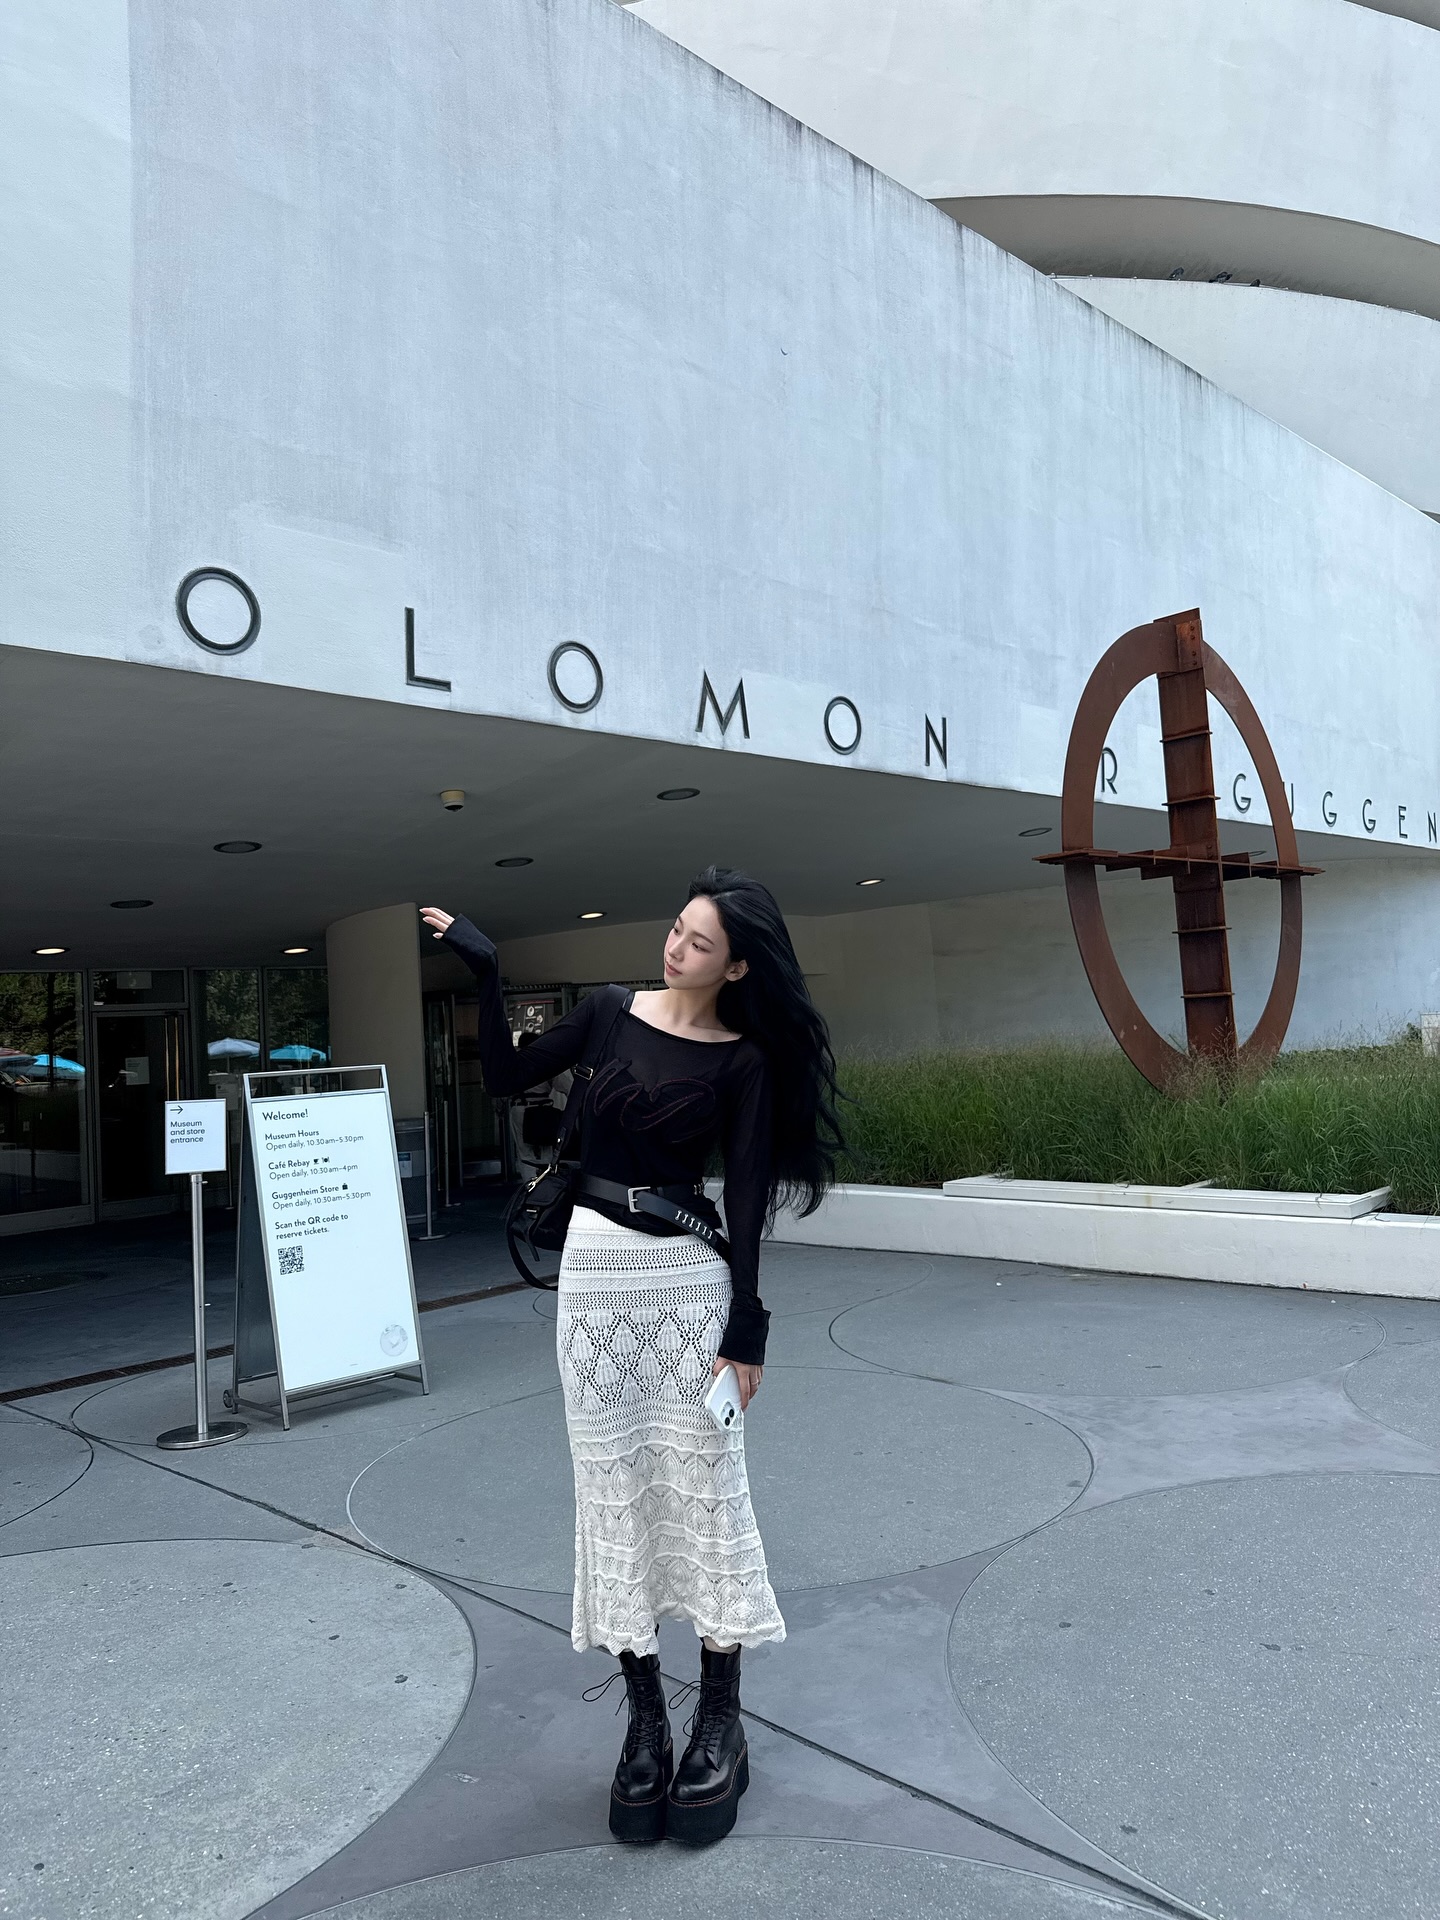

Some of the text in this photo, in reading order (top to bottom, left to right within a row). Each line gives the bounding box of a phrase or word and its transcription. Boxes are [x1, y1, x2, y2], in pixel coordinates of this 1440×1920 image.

[175, 566, 948, 769] OLOMON
[1101, 747, 1118, 794] R
[262, 1108, 309, 1121] Welcome!
[170, 1120, 203, 1128] Museum
[170, 1136, 204, 1144] entrance
[265, 1129, 320, 1141] Museum Hours
[265, 1142, 287, 1151] Open
[288, 1140, 306, 1149] daily,
[268, 1159, 310, 1170] Café Rebay
[269, 1171, 290, 1180] Open
[291, 1169, 309, 1178] daily,
[271, 1185, 340, 1200] Guggenheim Store
[272, 1201, 294, 1210] Open
[295, 1198, 312, 1207] daily,
[275, 1221, 293, 1230] Scan
[294, 1219, 307, 1227] the
[307, 1216, 321, 1225] QR
[322, 1213, 340, 1223] code
[276, 1226, 330, 1240] reserve tickets.
